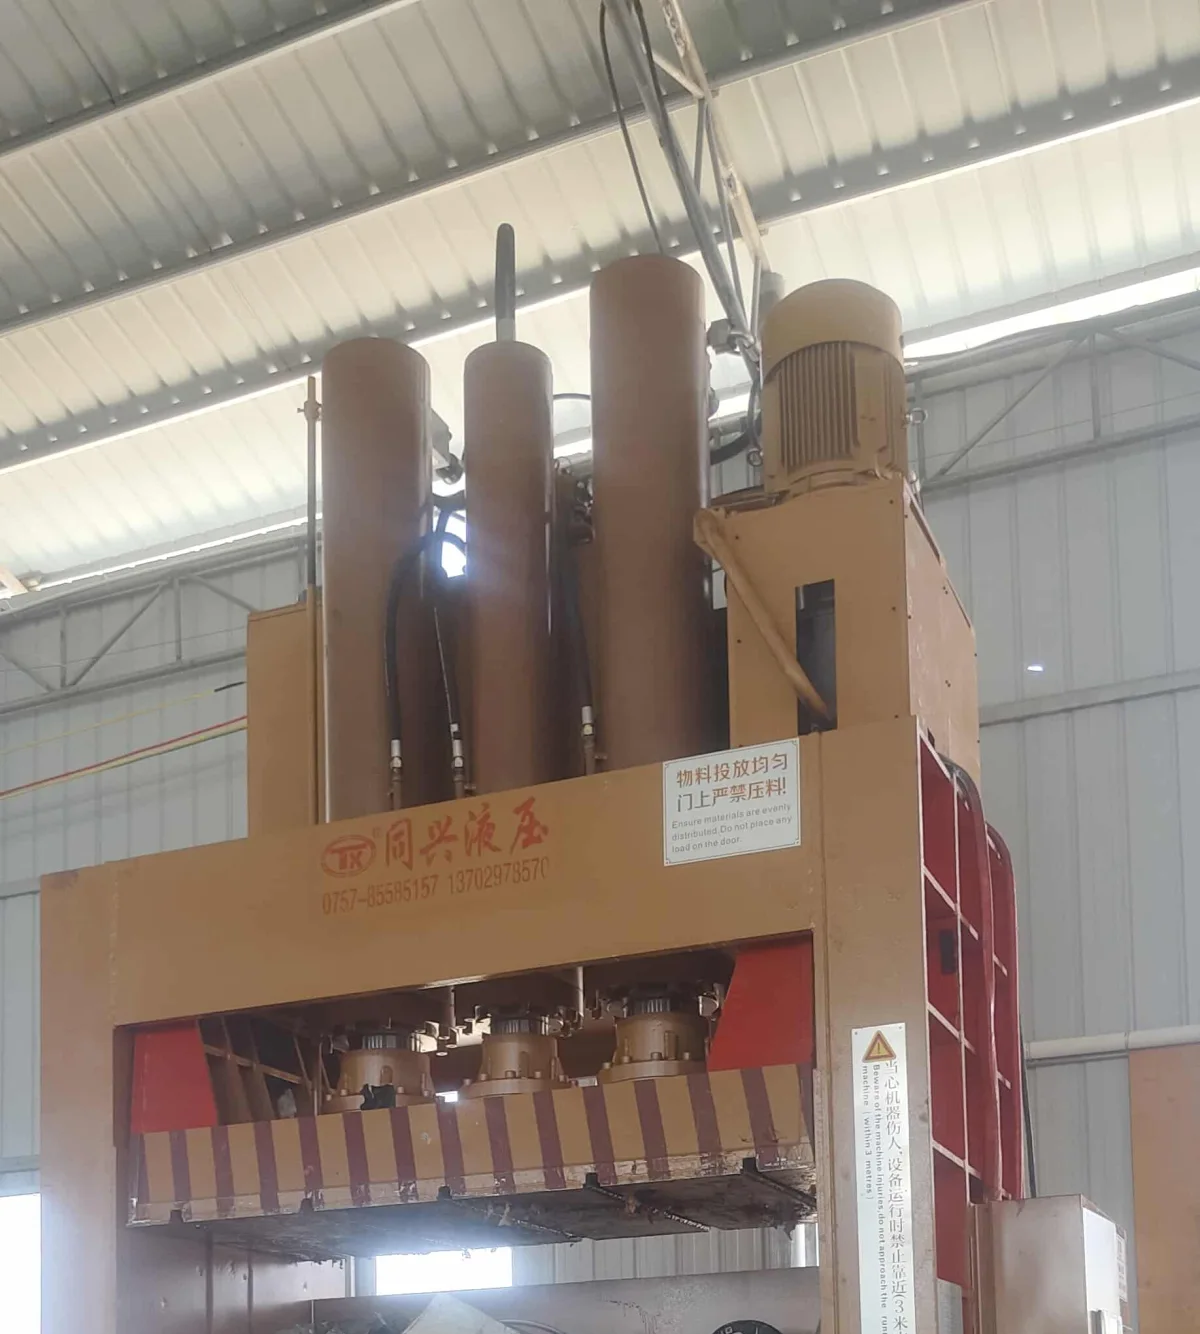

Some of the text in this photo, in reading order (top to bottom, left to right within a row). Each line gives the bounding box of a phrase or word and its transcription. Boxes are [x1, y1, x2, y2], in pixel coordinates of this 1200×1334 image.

[676, 753, 788, 788] 物料投放均匀
[671, 803, 791, 829] Ensure materials are evenly
[734, 822, 748, 831] not
[750, 818, 774, 830] place
[775, 815, 793, 825] any
[385, 797, 548, 871] 同兴液压
[671, 843, 690, 853] load
[691, 842, 703, 850] on
[704, 840, 719, 848] the
[862, 1065, 870, 1106] machine
[873, 1064, 881, 1100] Beware
[874, 1102, 882, 1111] of
[875, 1113, 883, 1129] the
[875, 1131, 885, 1171] machine
[878, 1227, 886, 1243] not
[878, 1246, 888, 1290] approach
[880, 1292, 889, 1308] the
